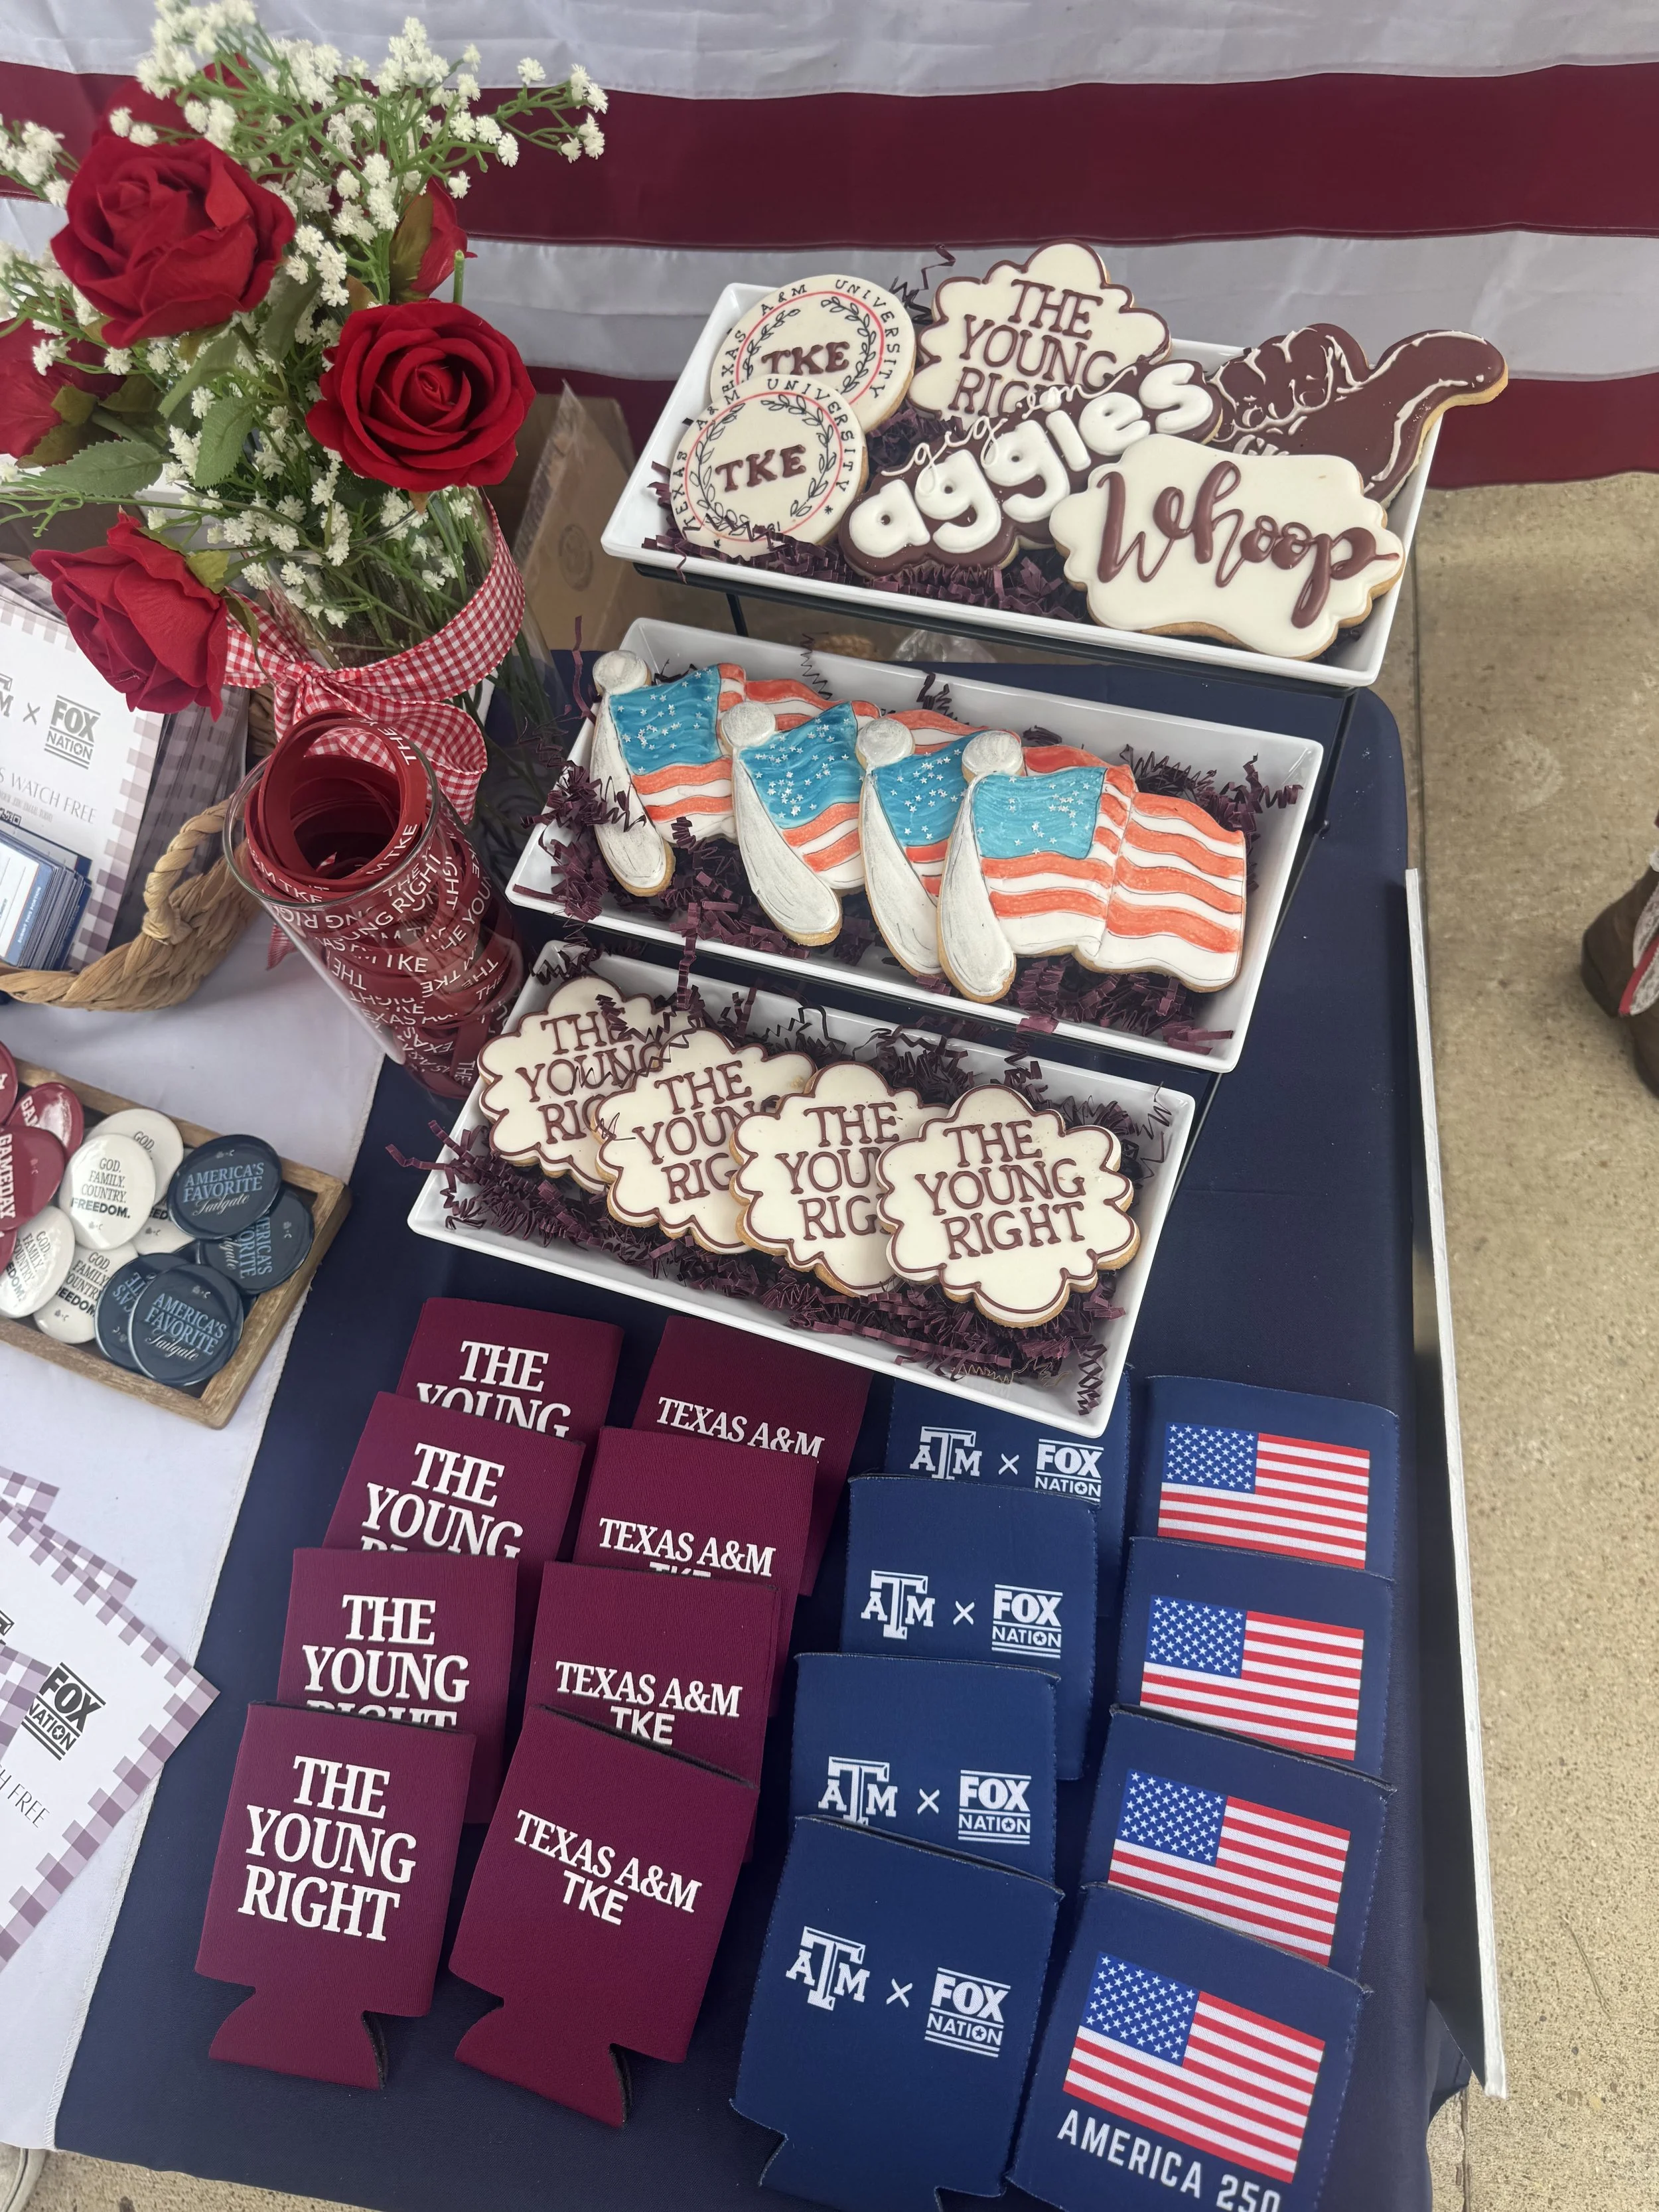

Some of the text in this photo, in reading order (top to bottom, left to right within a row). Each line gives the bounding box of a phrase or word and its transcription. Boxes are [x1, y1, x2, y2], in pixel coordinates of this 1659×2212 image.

[1008, 279, 1102, 341] THE
[721, 330, 747, 392] EXAS
[835, 279, 901, 398] UNIVERSITY
[761, 341, 850, 376] TKE
[959, 315, 1118, 390] YOUNG
[672, 451, 696, 528] TEXAS
[767, 378, 856, 492] UNIVERSITY
[715, 444, 807, 492] TKE
[849, 362, 1213, 557] aggies
[1097, 461, 1400, 628] Whoop
[46, 730, 93, 760] NATION
[51, 700, 100, 743] FOX
[378, 727, 417, 766] THE
[11, 773, 60, 809] WATCH
[63, 796, 98, 826] FREE
[384, 824, 417, 860] TKE
[383, 863, 420, 897] THE
[332, 958, 366, 990] THE
[654, 1061, 752, 1115] THE
[802, 1101, 900, 1147] THE
[942, 1120, 1042, 1167] THE
[89, 1170, 125, 1188] FAMILY.
[100, 1157, 121, 1173] GOD.
[185, 1162, 265, 1188] AMERICA'S
[661, 1153, 738, 1205] RIG
[914, 1158, 1086, 1216] YOUNG
[70, 1197, 131, 1218] FREEDOM.
[81, 1184, 127, 1203] COUNTRY.
[183, 1176, 263, 1203] FAVORITE
[192, 1195, 250, 1216] Tailgate
[798, 1195, 890, 1241] RIG
[940, 1201, 1085, 1260] RIGHT
[89, 1252, 110, 1272] GOD.
[239, 1225, 257, 1280] ORITE
[145, 1307, 218, 1356] FAVORITE
[153, 1293, 226, 1339] AMERICA'S
[145, 1329, 199, 1361] Tailgate
[458, 1340, 549, 1393] THE
[656, 1396, 825, 1458] TEXAS A&M
[411, 1442, 505, 1508] THE
[1036, 1443, 1104, 1479] FOX
[1034, 1476, 1102, 1497] NATION
[361, 1482, 524, 1559] YOUNG
[599, 1517, 776, 1578] TEXAS A&M
[342, 1594, 436, 1646] THE
[993, 1589, 1062, 1627] FOX
[991, 1625, 1062, 1649] NATION
[301, 1645, 470, 1704] YOUNG
[555, 1660, 743, 1718] TEXAS A&M
[38, 1666, 102, 1733] FOX
[610, 1706, 676, 1747] TKE
[7, 1783, 50, 1828] FREE
[293, 1755, 390, 1820] THE
[960, 1775, 1031, 1812] FOX
[246, 1804, 417, 1884] YOUNG
[958, 1814, 1031, 1834] NATION
[513, 1808, 703, 1914] TEXAS A&M
[238, 1864, 400, 1942] RIGHT
[561, 1870, 629, 1926] TKE
[931, 1973, 1009, 2024] FOX
[927, 2012, 1003, 2046] NATION
[1056, 2108, 1281, 2212] AMERICA 250
